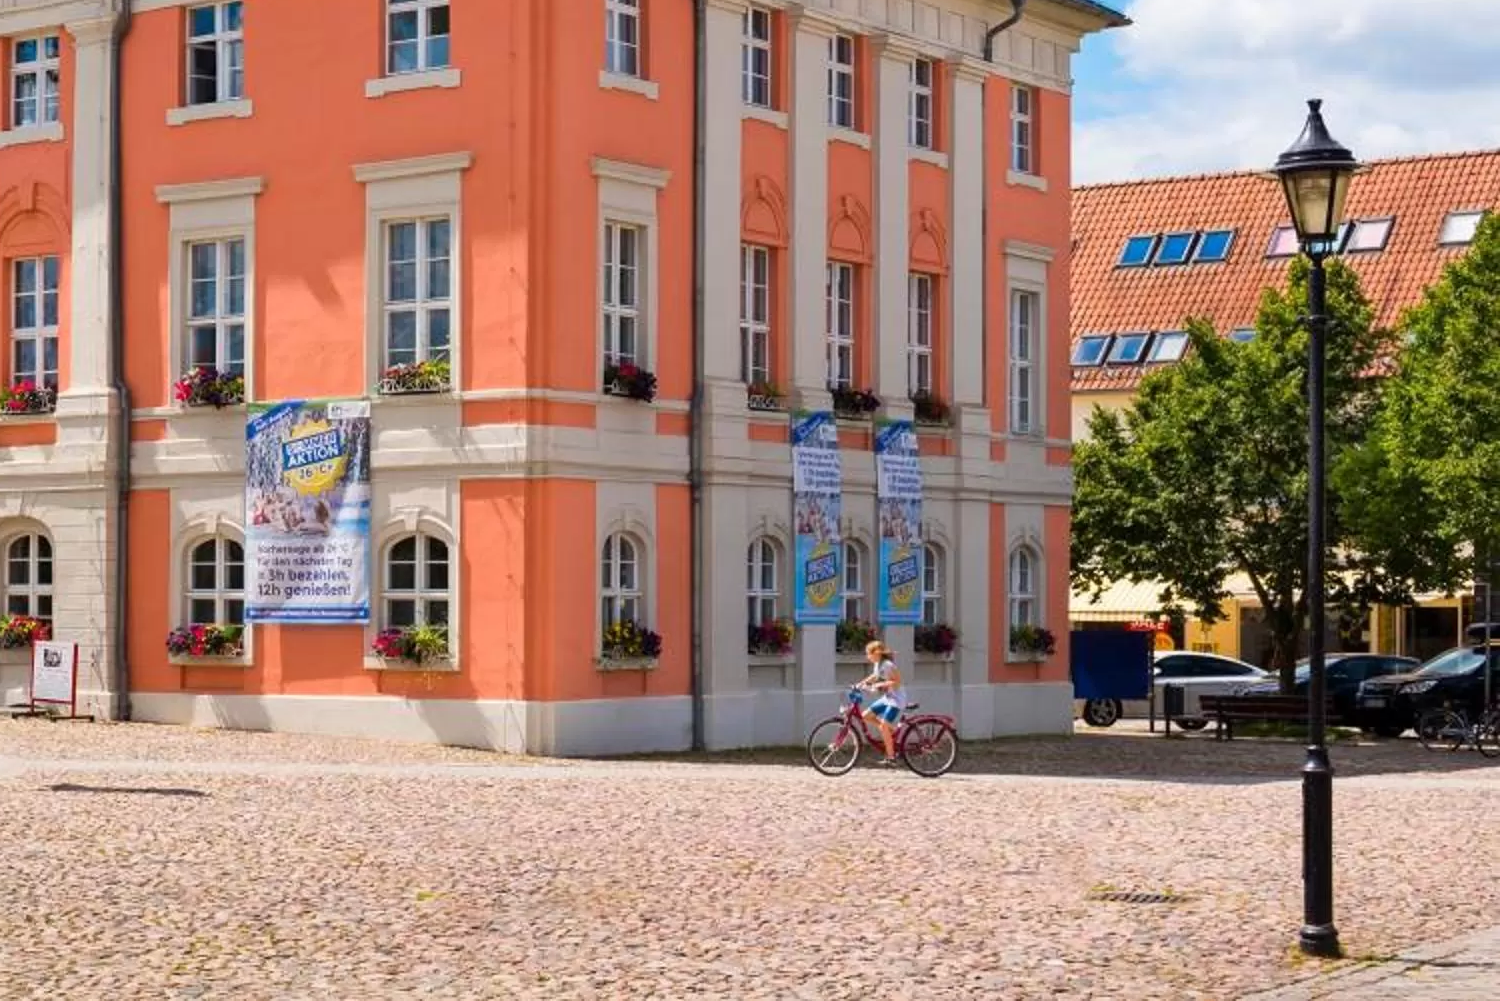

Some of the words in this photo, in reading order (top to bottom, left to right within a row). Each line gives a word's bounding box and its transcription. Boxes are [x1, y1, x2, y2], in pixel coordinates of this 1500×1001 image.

[287, 445, 339, 468] AKTION
[258, 584, 280, 596] 12h
[283, 583, 351, 599] genießen!
